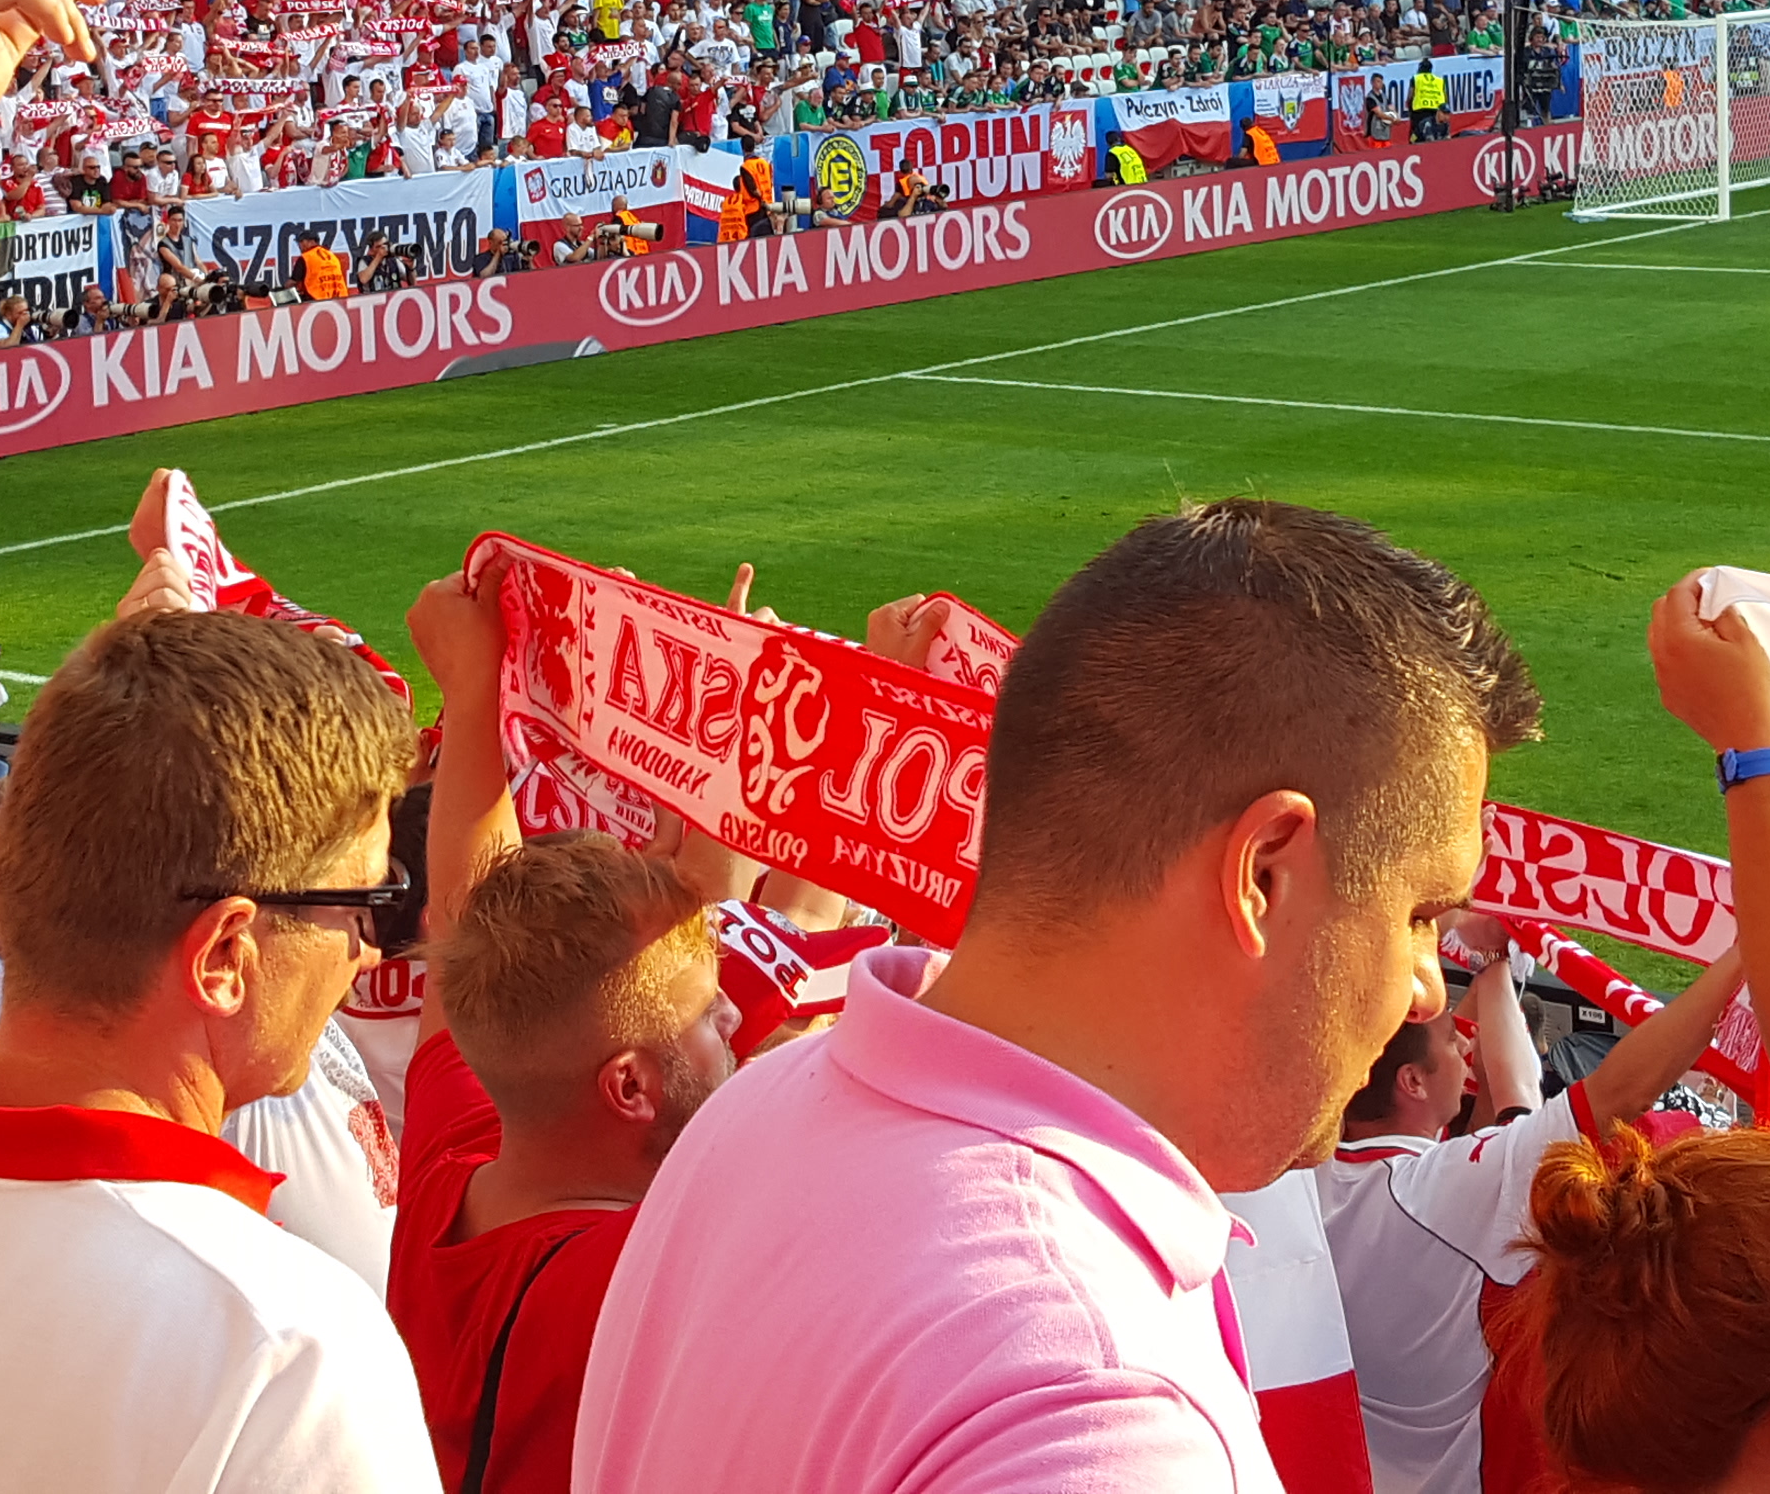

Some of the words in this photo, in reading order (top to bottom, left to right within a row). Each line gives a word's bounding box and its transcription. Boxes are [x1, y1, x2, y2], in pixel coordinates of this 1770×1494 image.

[869, 106, 1042, 201] TORUŃ
[1607, 110, 1719, 172] MOTOR
[549, 165, 647, 201] GRUDZIĄDZ
[1183, 181, 1252, 241] KIA
[1265, 154, 1425, 230] MOTORS
[5, 222, 94, 270] ORTOWY
[715, 240, 808, 306] KIA
[824, 201, 1030, 289] MOTORS
[1105, 206, 1162, 244] KIA
[615, 269, 687, 313] KIA
[90, 318, 214, 406] KIA
[237, 277, 513, 384] MOTORS
